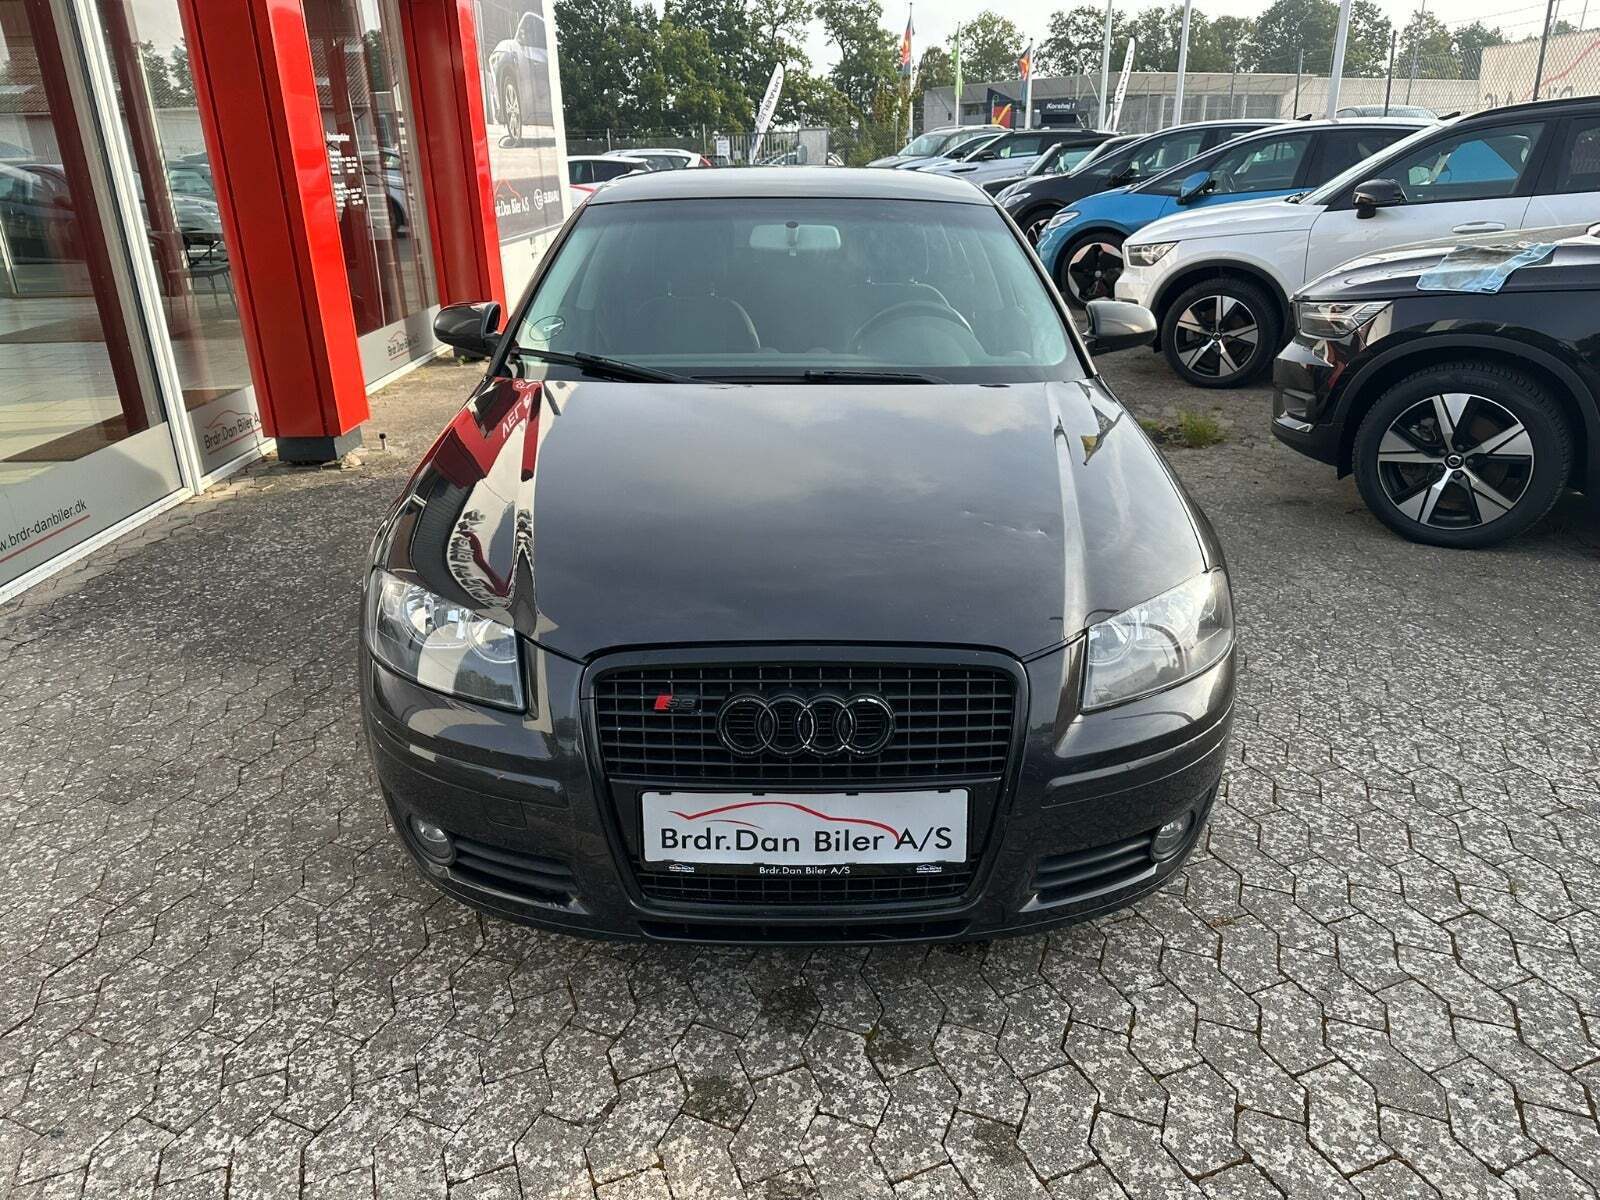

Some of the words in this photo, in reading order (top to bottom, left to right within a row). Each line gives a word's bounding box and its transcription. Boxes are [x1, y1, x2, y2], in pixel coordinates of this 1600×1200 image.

[660, 828, 800, 852] Brdr.Dan
[815, 829, 885, 851] Biler
[894, 827, 952, 851] A/S
[759, 866, 802, 875] Brdr.Dan
[805, 866, 827, 875] Biler
[830, 866, 851, 875] A/S
